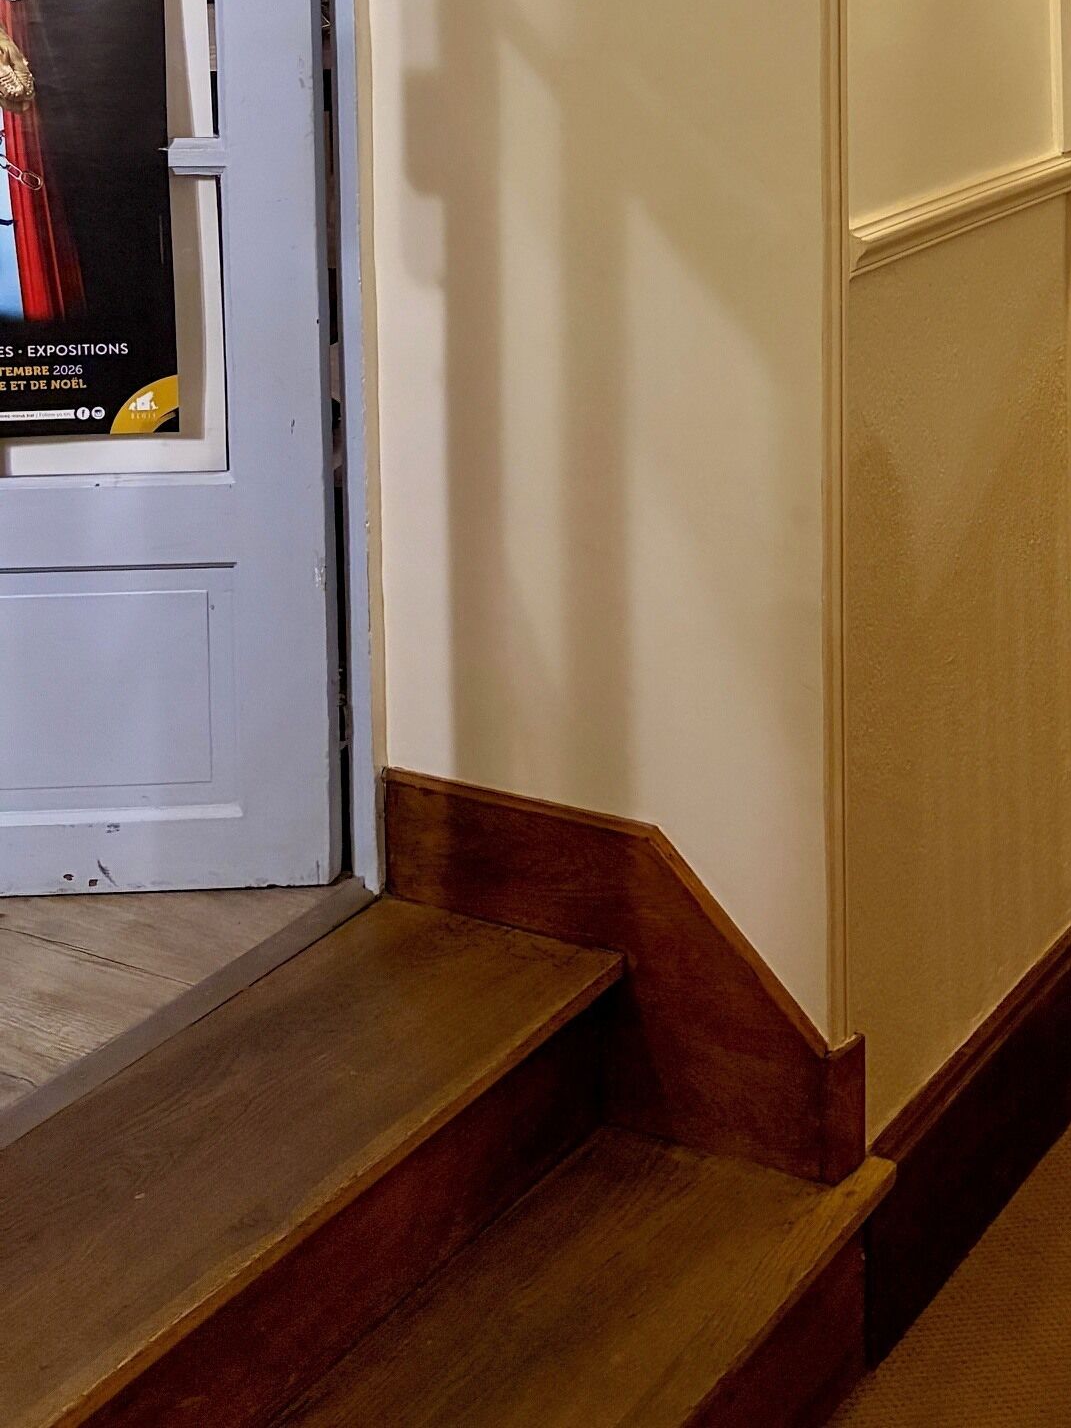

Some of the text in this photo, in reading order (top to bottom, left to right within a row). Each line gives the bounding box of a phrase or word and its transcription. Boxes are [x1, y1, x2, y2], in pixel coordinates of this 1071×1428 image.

[27, 343, 129, 357] EXPOSITIONS
[52, 364, 83, 376] 2026
[10, 380, 27, 391] ET
[30, 379, 48, 390] DE
[50, 376, 88, 389] NOËL
